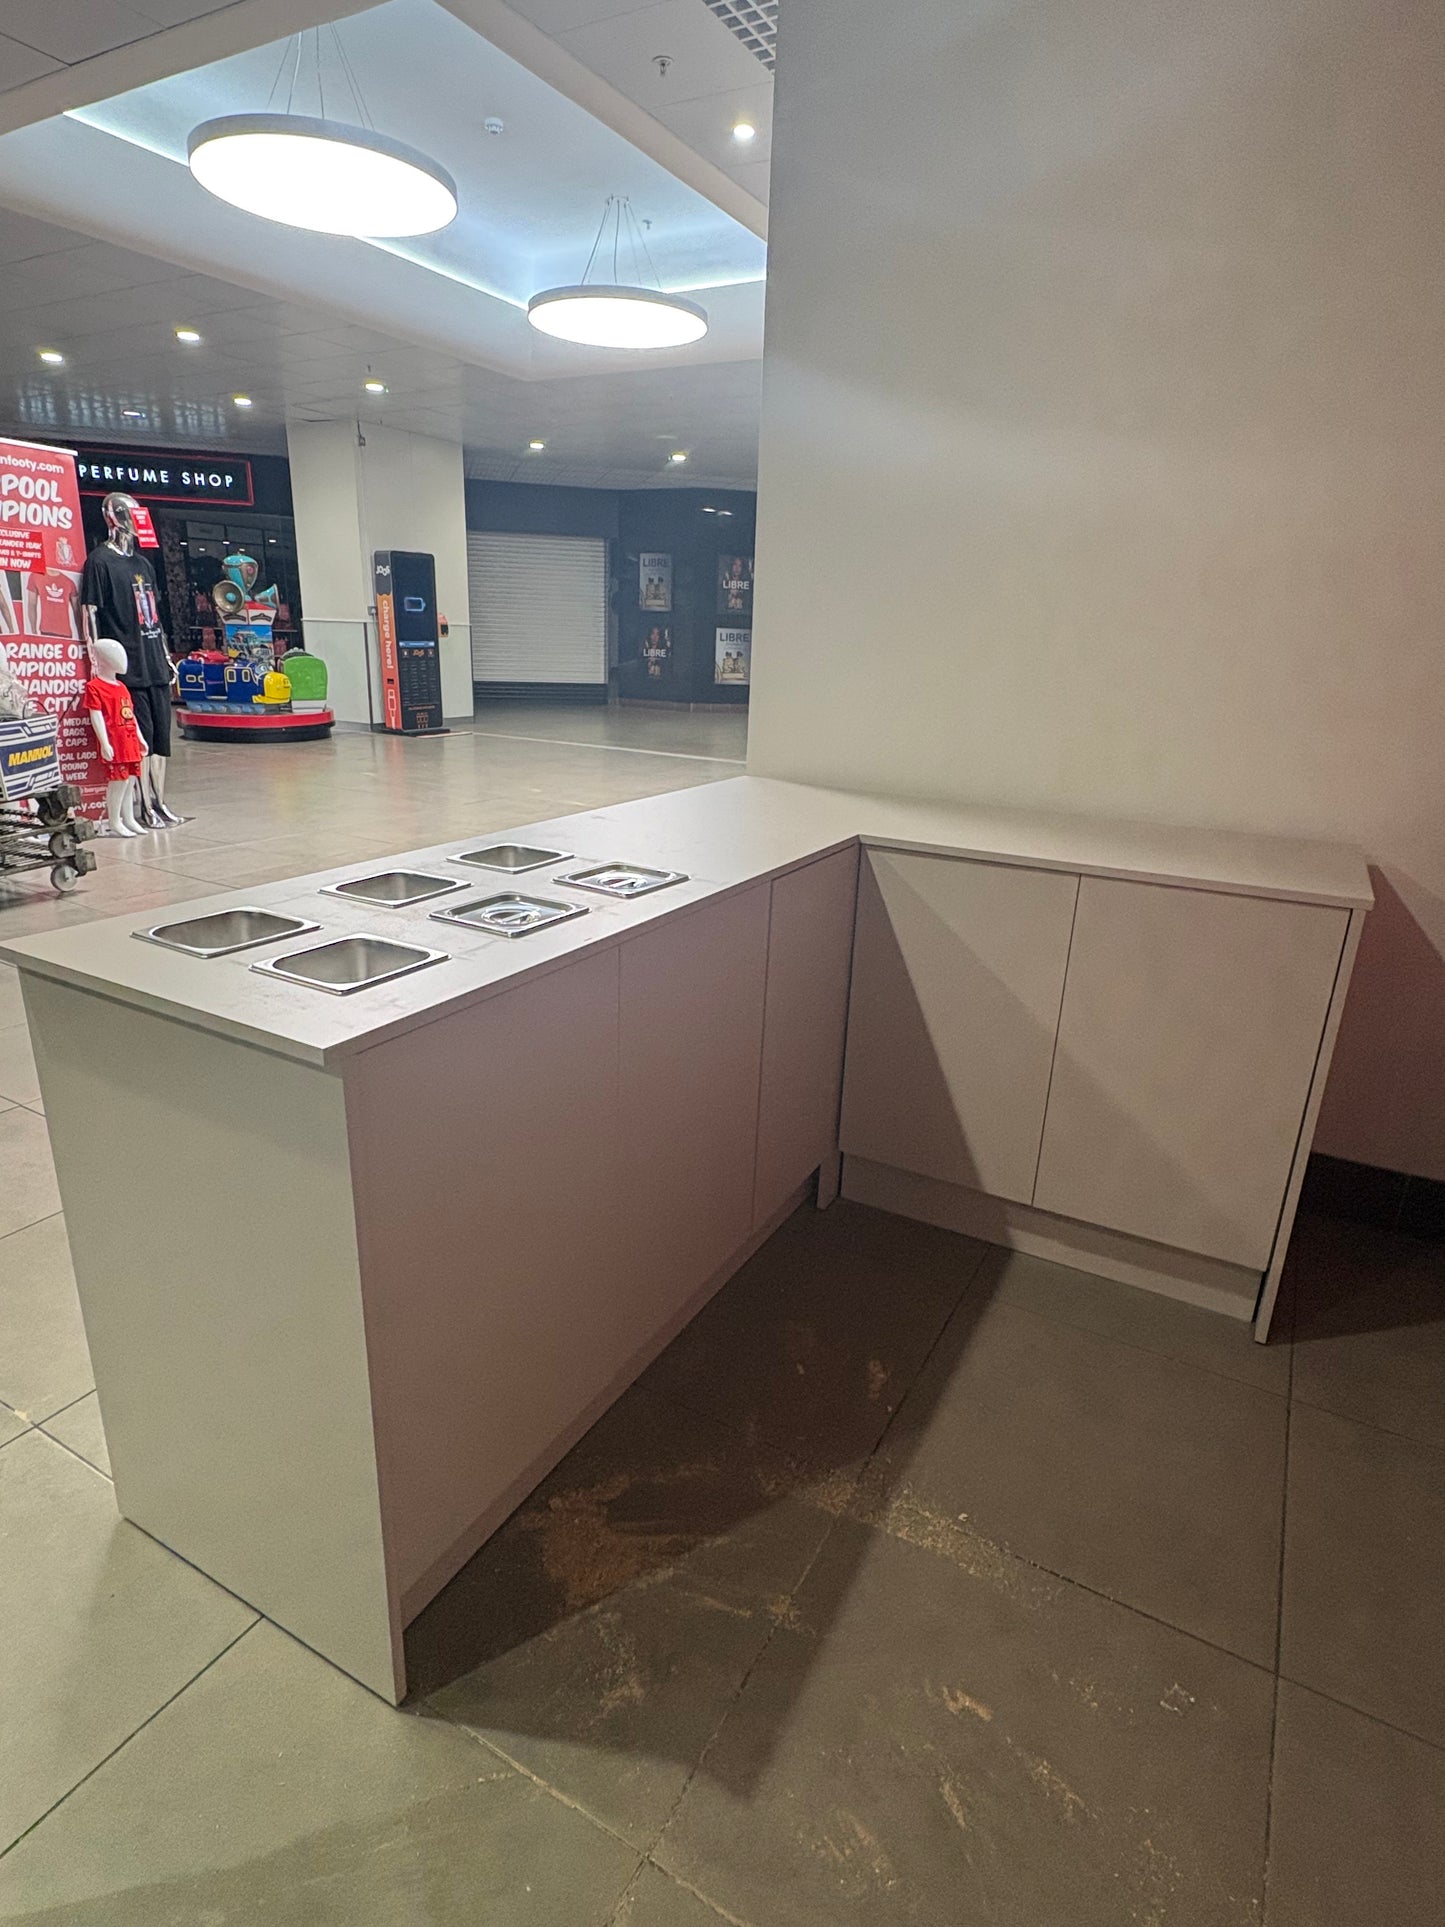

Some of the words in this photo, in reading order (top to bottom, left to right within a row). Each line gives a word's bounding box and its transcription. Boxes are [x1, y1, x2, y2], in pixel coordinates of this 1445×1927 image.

[78, 464, 169, 483] PERFUME
[181, 471, 233, 488] SHOP
[0, 499, 73, 530] PIONS
[9, 558, 32, 570] NOW
[642, 558, 670, 568] LIBRE
[722, 580, 750, 590] LIBRE
[382, 599, 391, 639] charge
[720, 632, 751, 642] LIBRE
[5, 642, 63, 660] RANGE
[67, 643, 87, 660] OF
[385, 640, 394, 669] here!
[643, 648, 667, 658] LIBRE
[43, 696, 80, 713] CITY
[65, 738, 88, 747] CAPS
[8, 745, 54, 767] MANNOL
[58, 753, 75, 761] CAL
[76, 752, 97, 760] LADS
[61, 762, 89, 772] ROUND
[66, 772, 88, 781] WEEK
